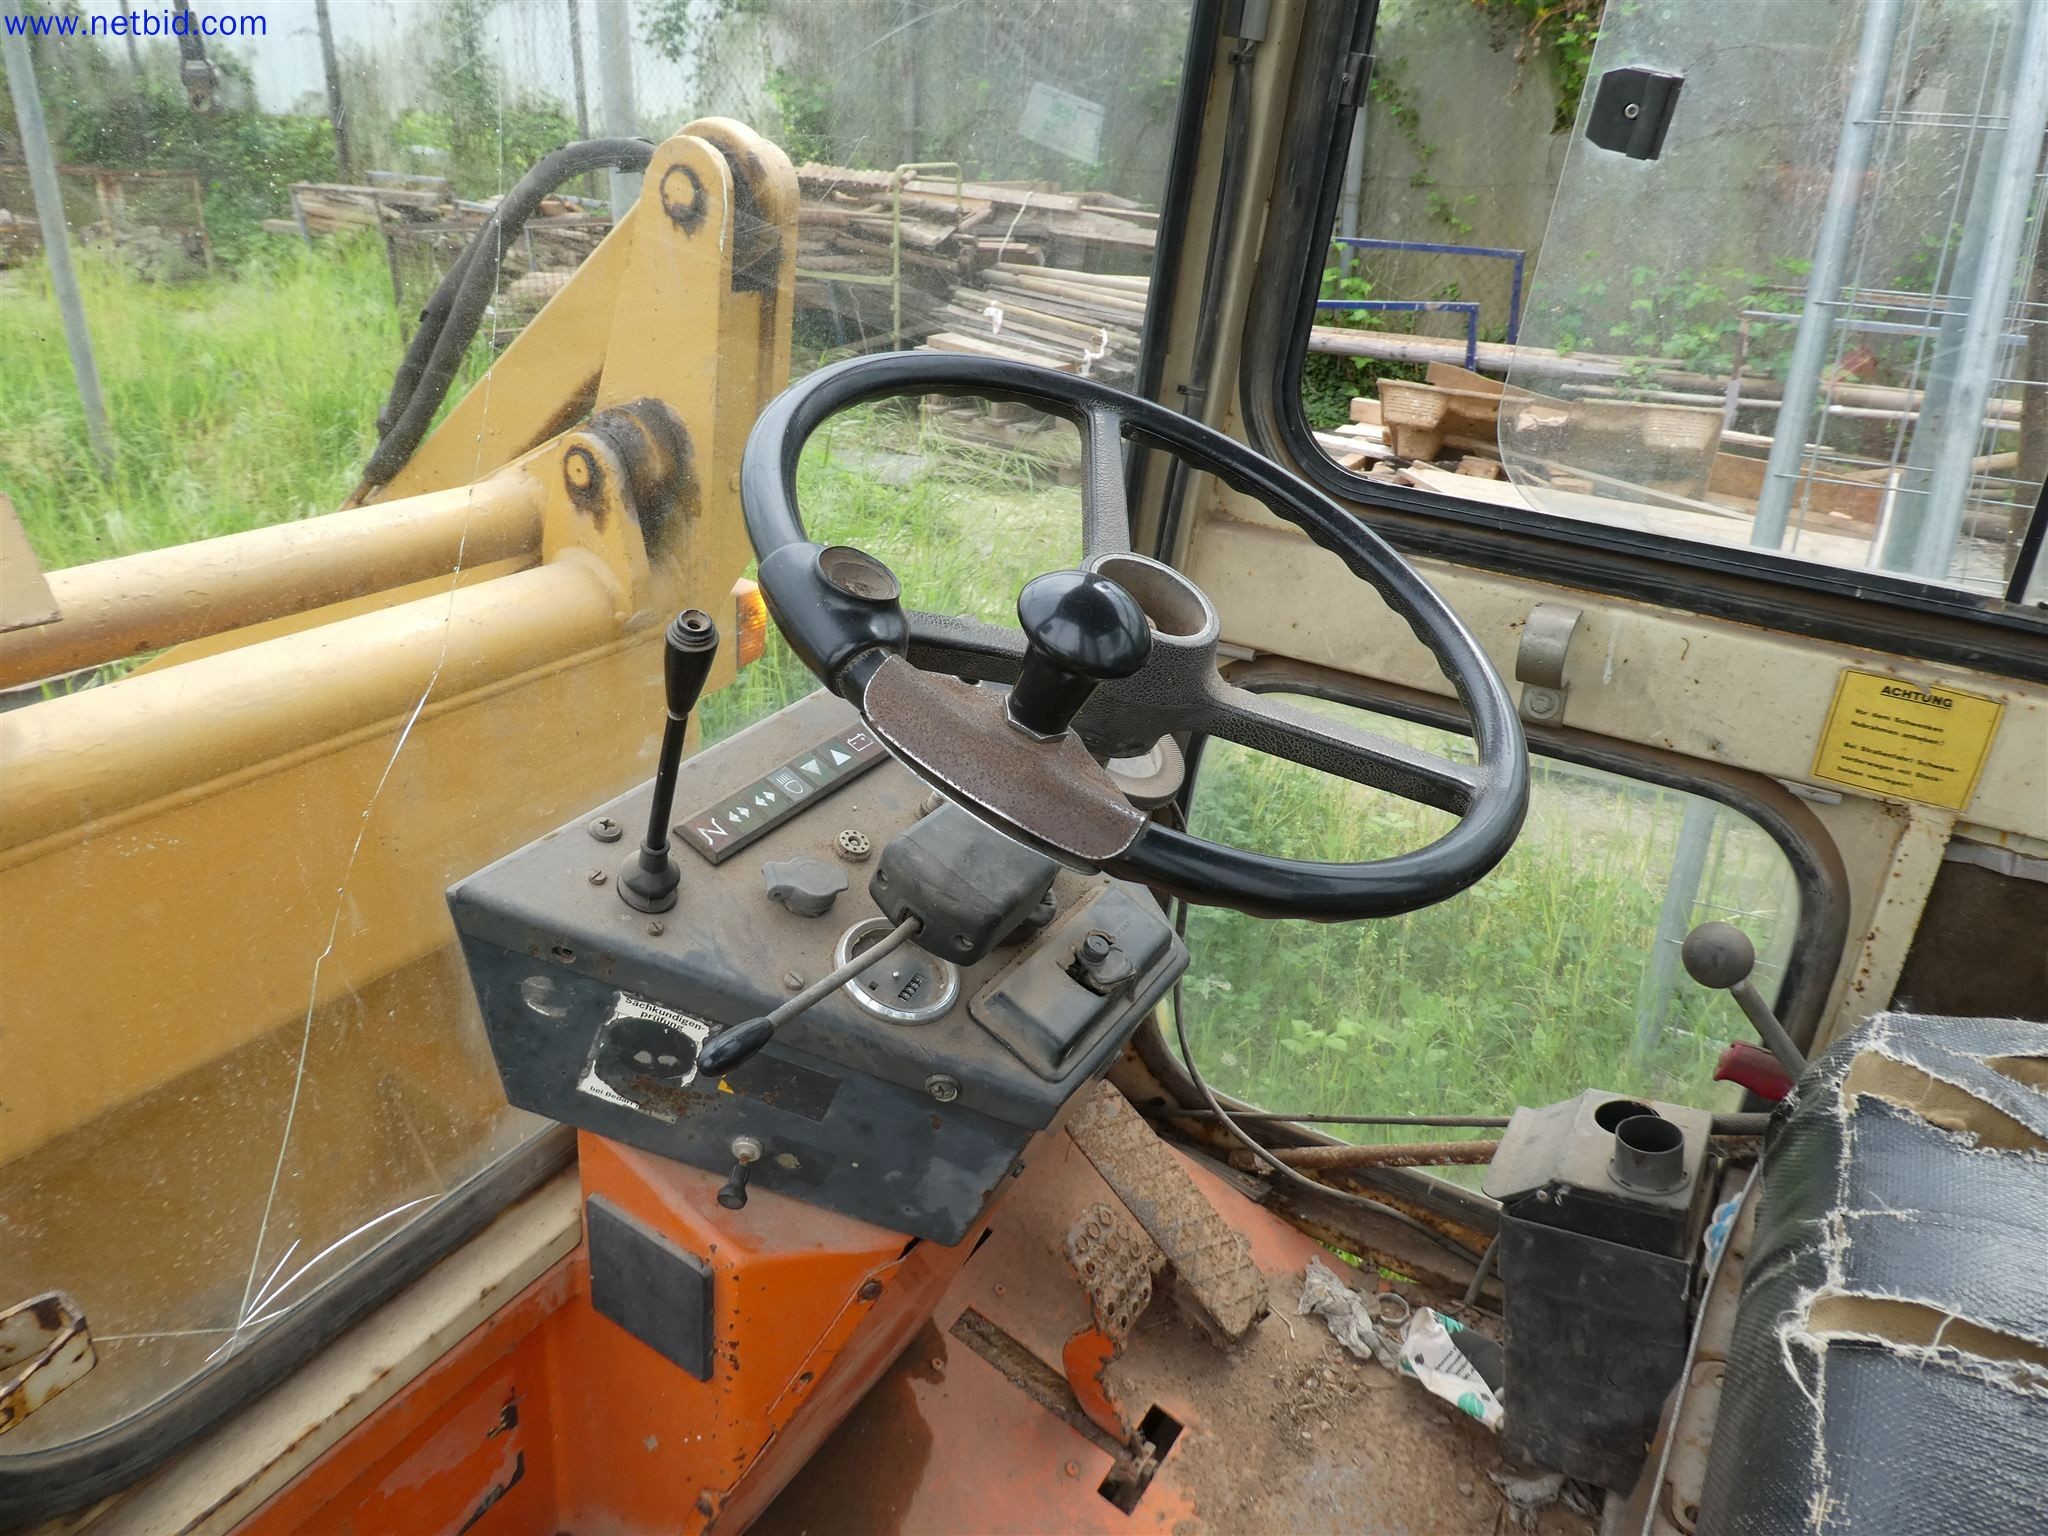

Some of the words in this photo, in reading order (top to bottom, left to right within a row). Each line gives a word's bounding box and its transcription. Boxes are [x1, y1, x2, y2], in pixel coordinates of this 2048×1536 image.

[1881, 685, 1953, 708] ACHTUNG
[625, 997, 705, 1031] Sachkundigen-
[640, 1011, 684, 1032] prüfung
